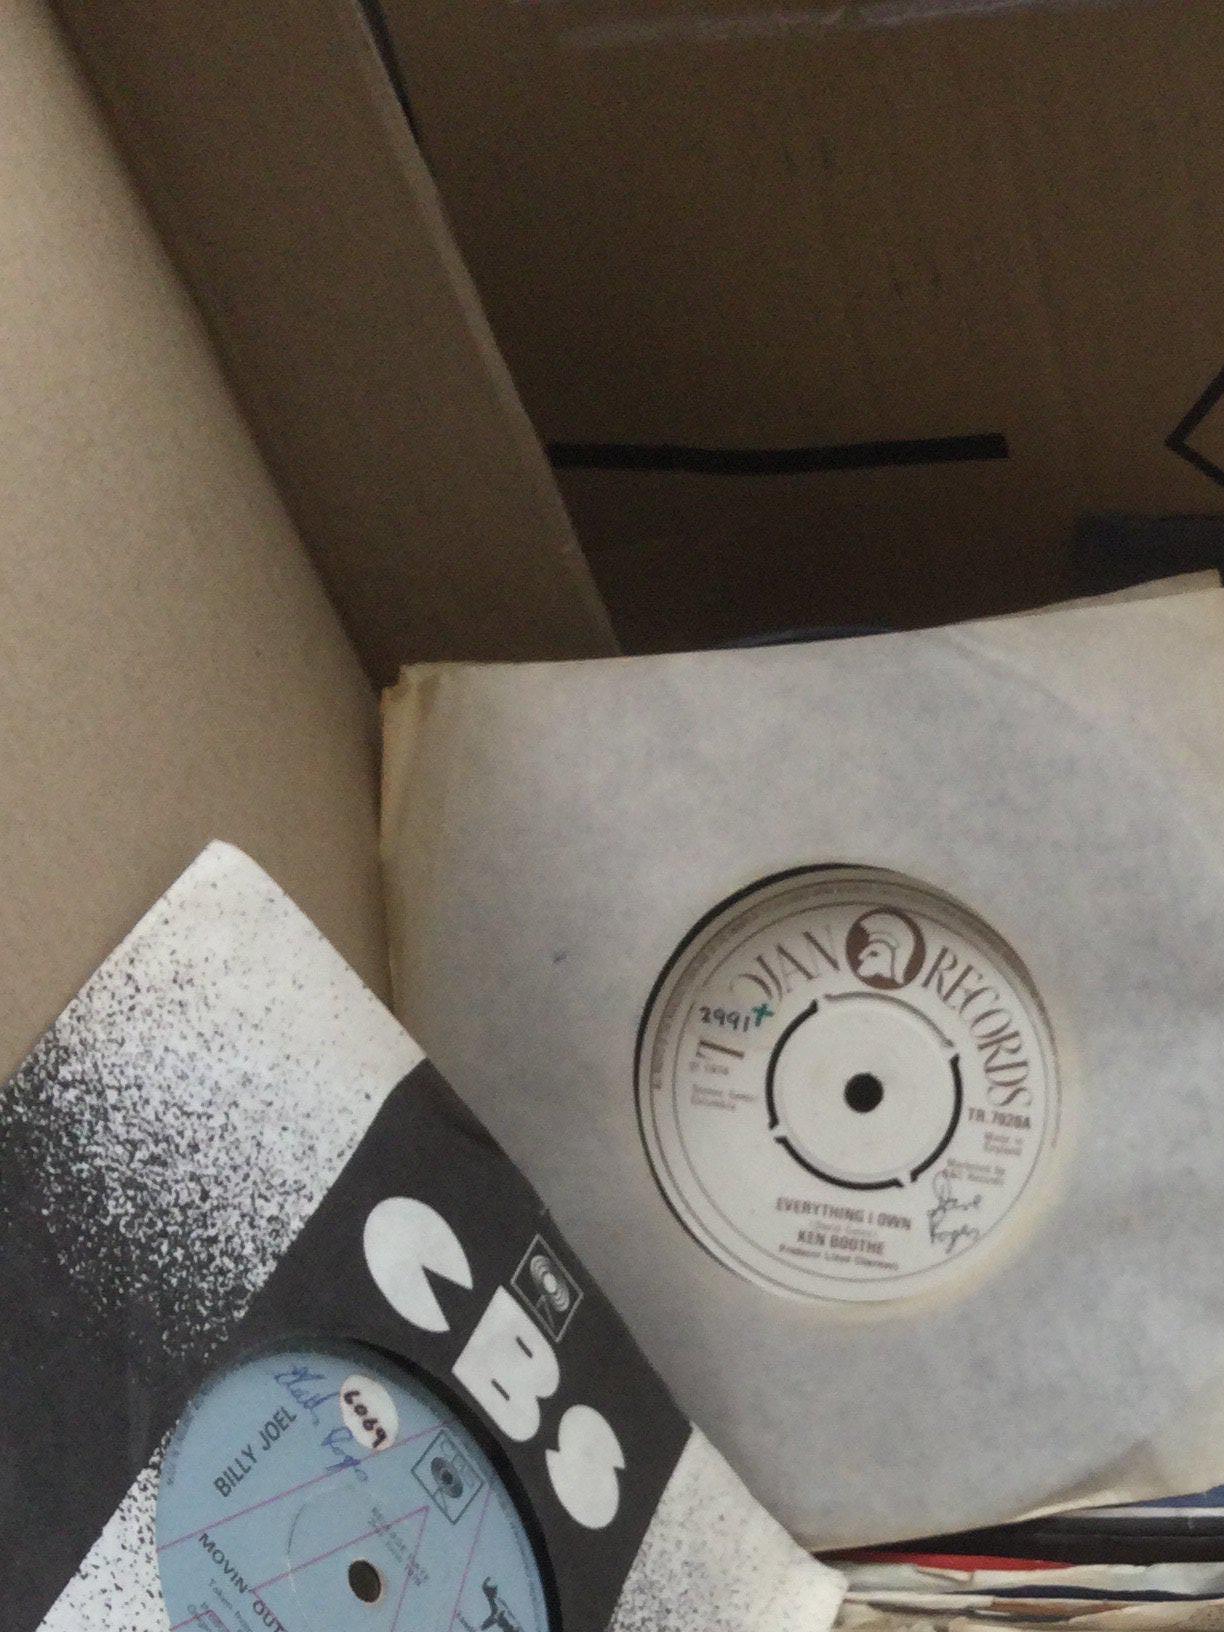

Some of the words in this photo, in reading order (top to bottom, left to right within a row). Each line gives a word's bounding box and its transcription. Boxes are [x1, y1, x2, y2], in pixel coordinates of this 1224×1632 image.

[921, 945, 1032, 1109] RECORDS
[775, 1196, 864, 1222] EVERYTHING
[363, 1196, 625, 1530] CBS
[213, 1451, 259, 1499] BILLY
[260, 1404, 299, 1452] JOEL
